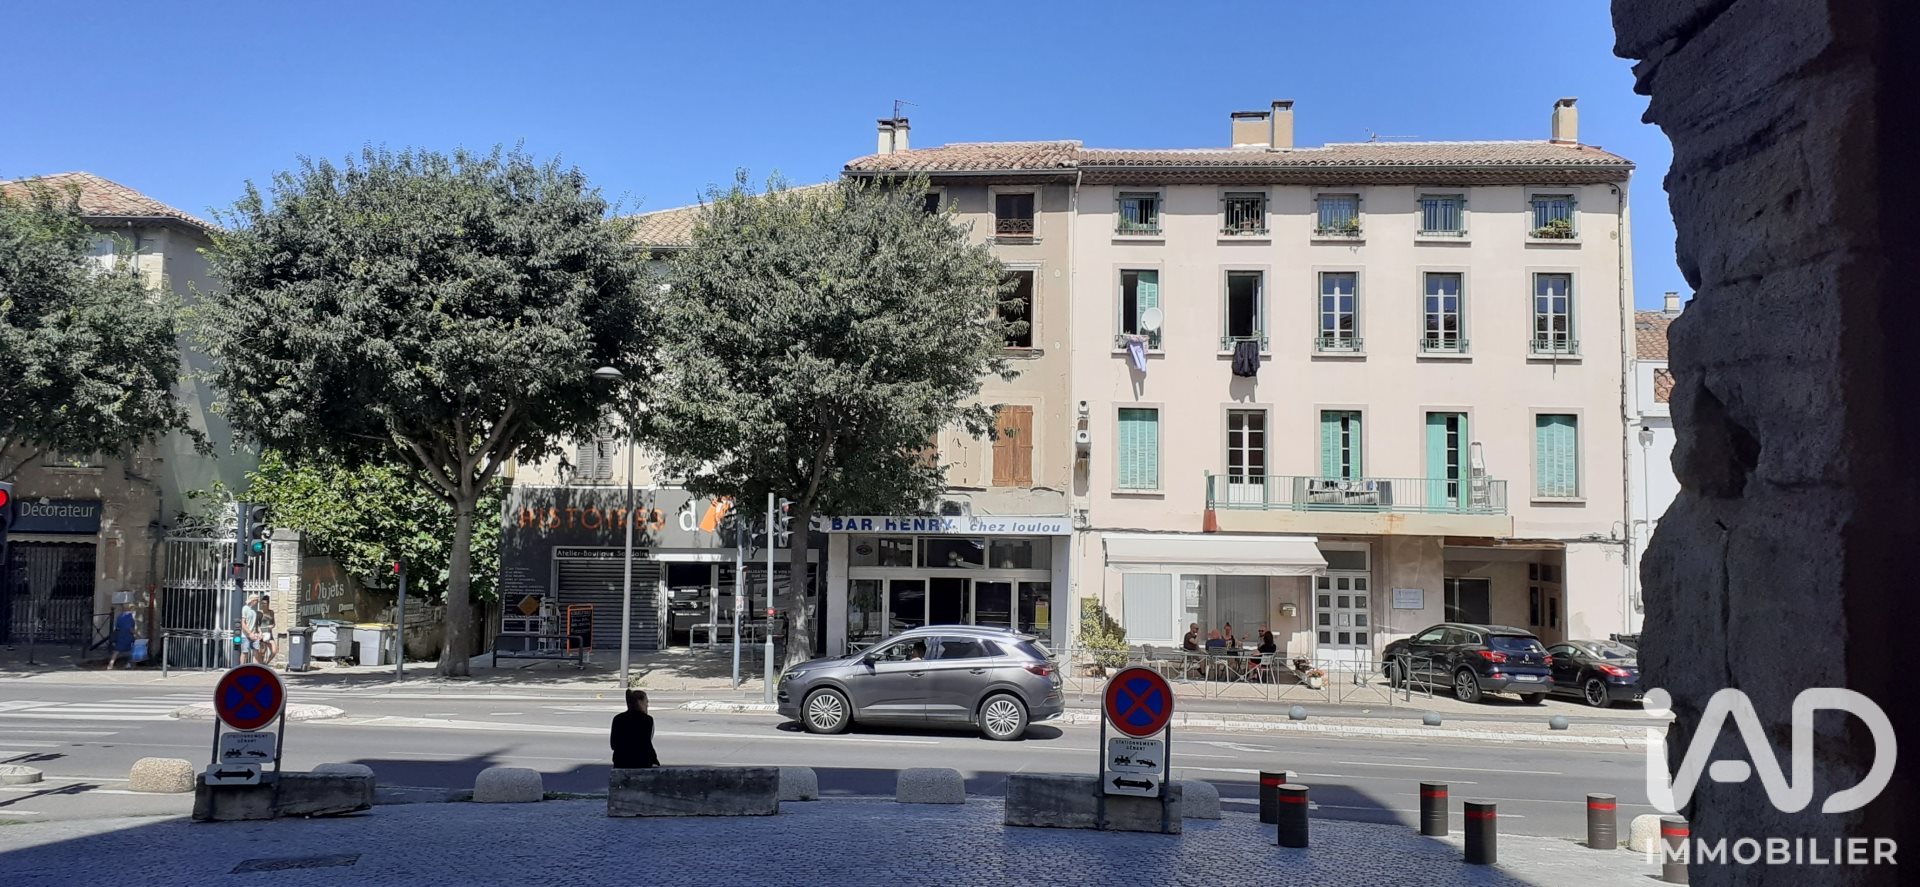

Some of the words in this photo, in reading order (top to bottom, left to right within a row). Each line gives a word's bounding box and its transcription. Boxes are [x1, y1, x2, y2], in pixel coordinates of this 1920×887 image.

[21, 501, 95, 518] Décorateur
[518, 507, 667, 532] HISTOIRES
[831, 517, 873, 531] BAR
[885, 517, 954, 532] HENRY
[969, 520, 1006, 533] chez
[1012, 521, 1062, 533] loulou
